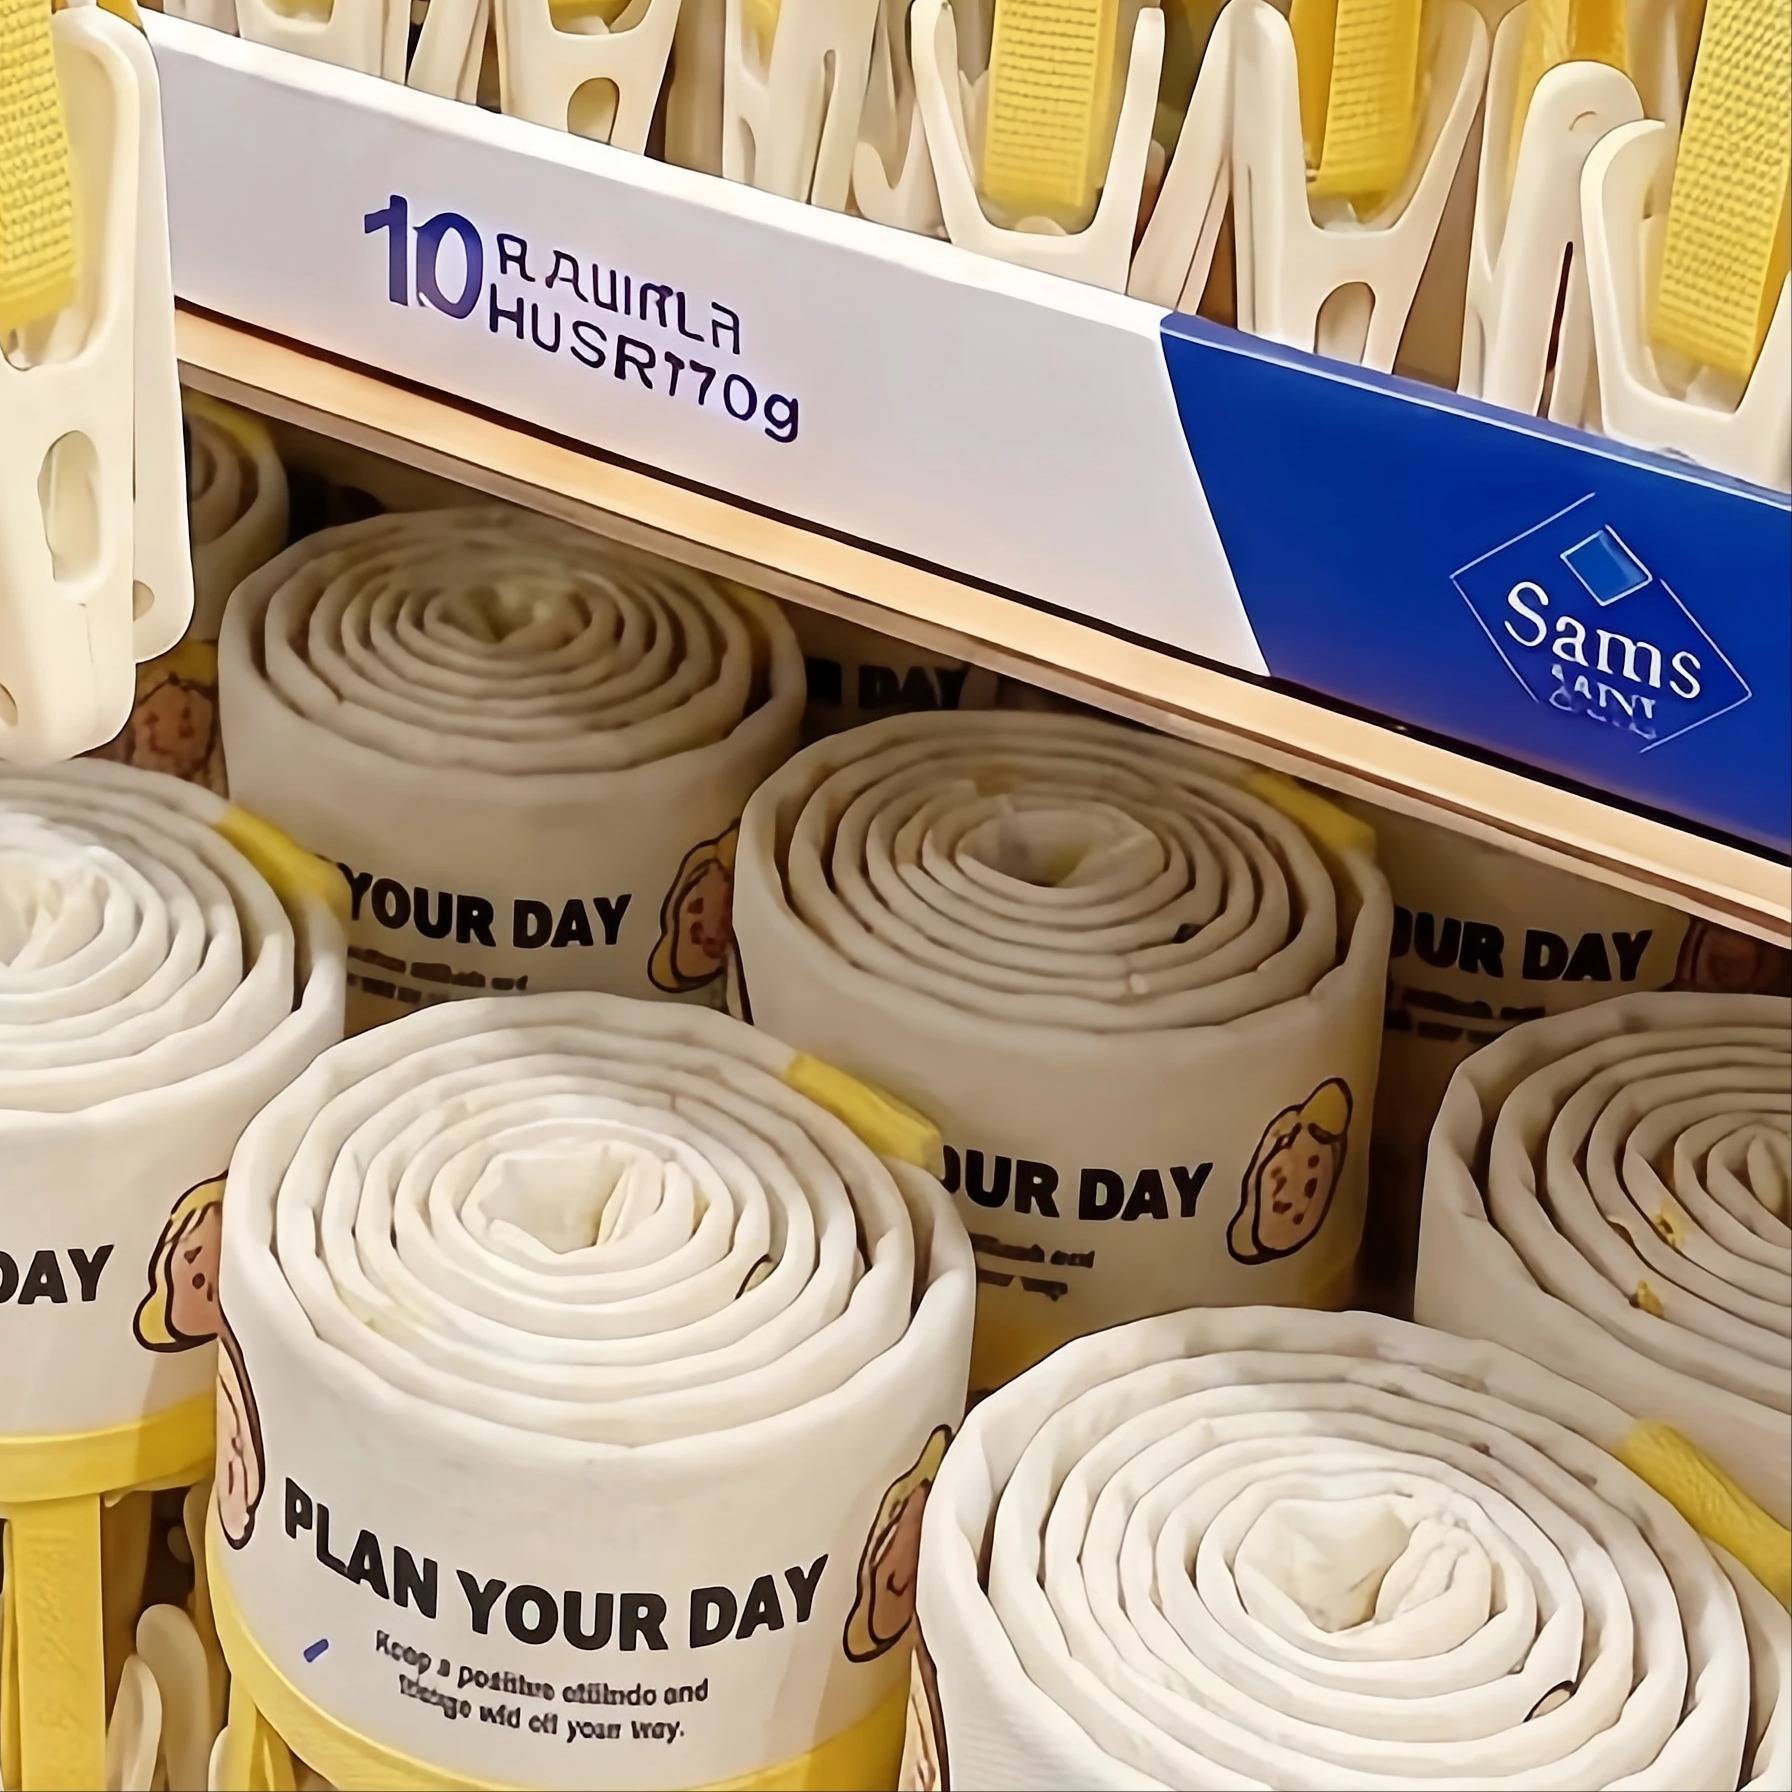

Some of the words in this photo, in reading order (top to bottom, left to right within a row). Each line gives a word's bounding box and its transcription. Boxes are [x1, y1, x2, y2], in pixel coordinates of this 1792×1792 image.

[364, 195, 484, 320] 10
[1504, 581, 1701, 699] Sams
[337, 862, 496, 947] YOUR
[513, 893, 632, 949] DAY
[1522, 928, 1654, 982] DAY
[1078, 1162, 1214, 1221] DAY
[284, 1476, 439, 1620] PLAN
[455, 1568, 670, 1652] YOUR
[688, 1553, 829, 1648] DAY
